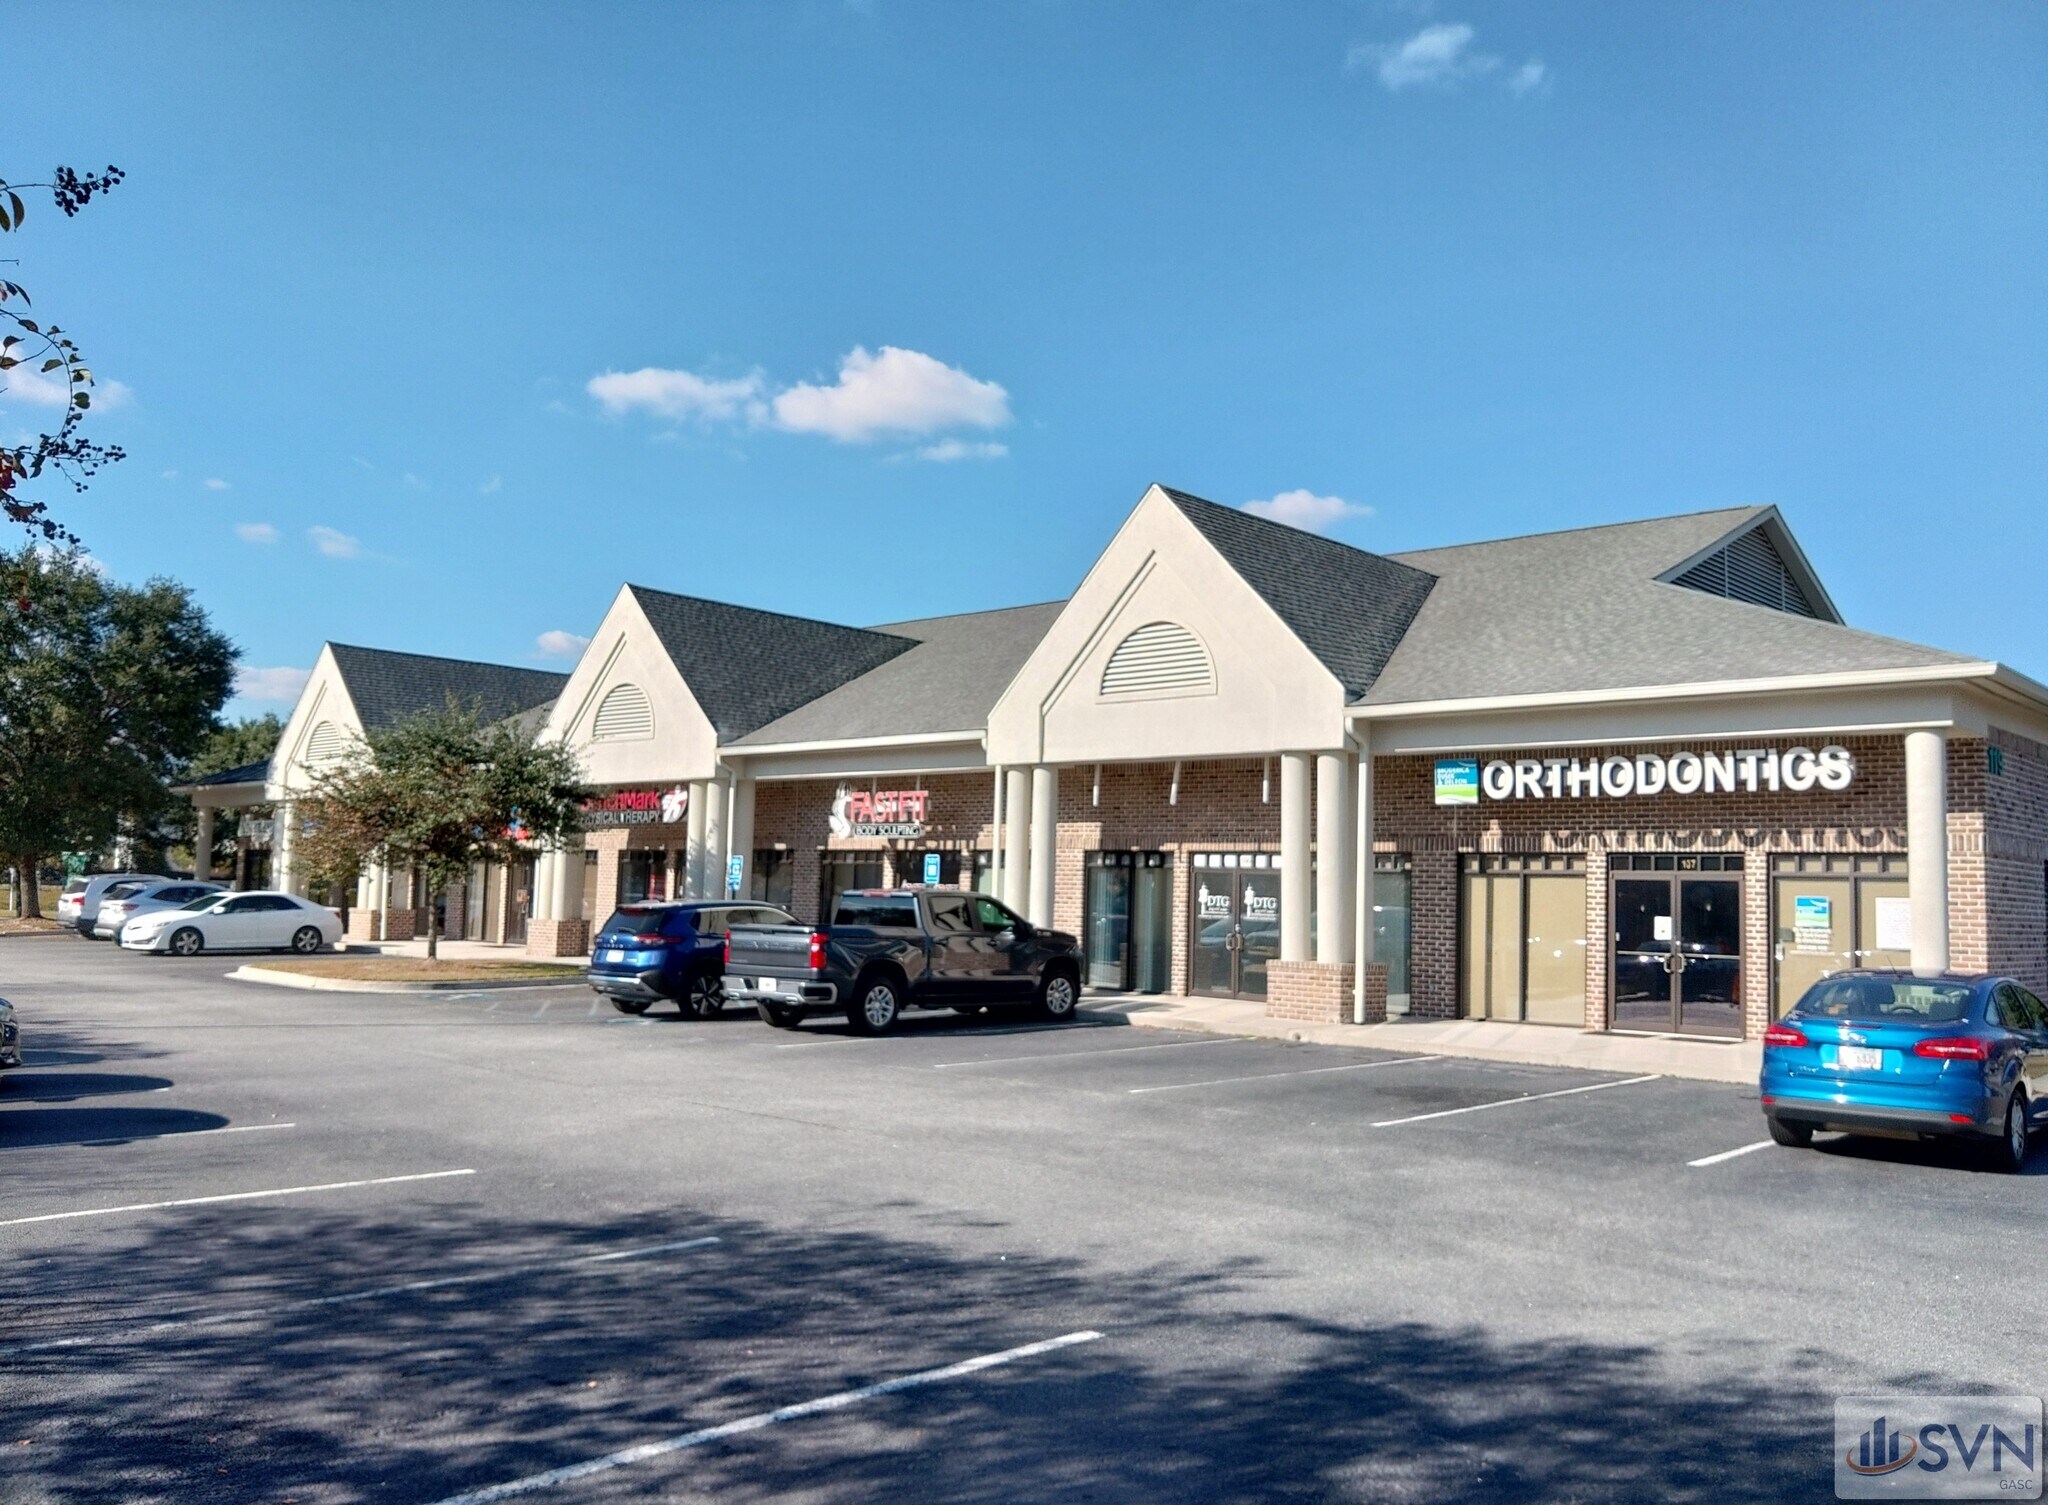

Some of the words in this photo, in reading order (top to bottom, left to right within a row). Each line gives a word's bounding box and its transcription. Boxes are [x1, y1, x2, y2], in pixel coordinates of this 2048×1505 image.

[1483, 745, 1851, 800] ORTHODONTICS
[620, 809, 660, 823] THERAPY
[856, 825, 877, 836] BODY
[879, 825, 919, 836] SCULPTING
[1207, 895, 1231, 907] DTG
[1253, 897, 1277, 909] DTG
